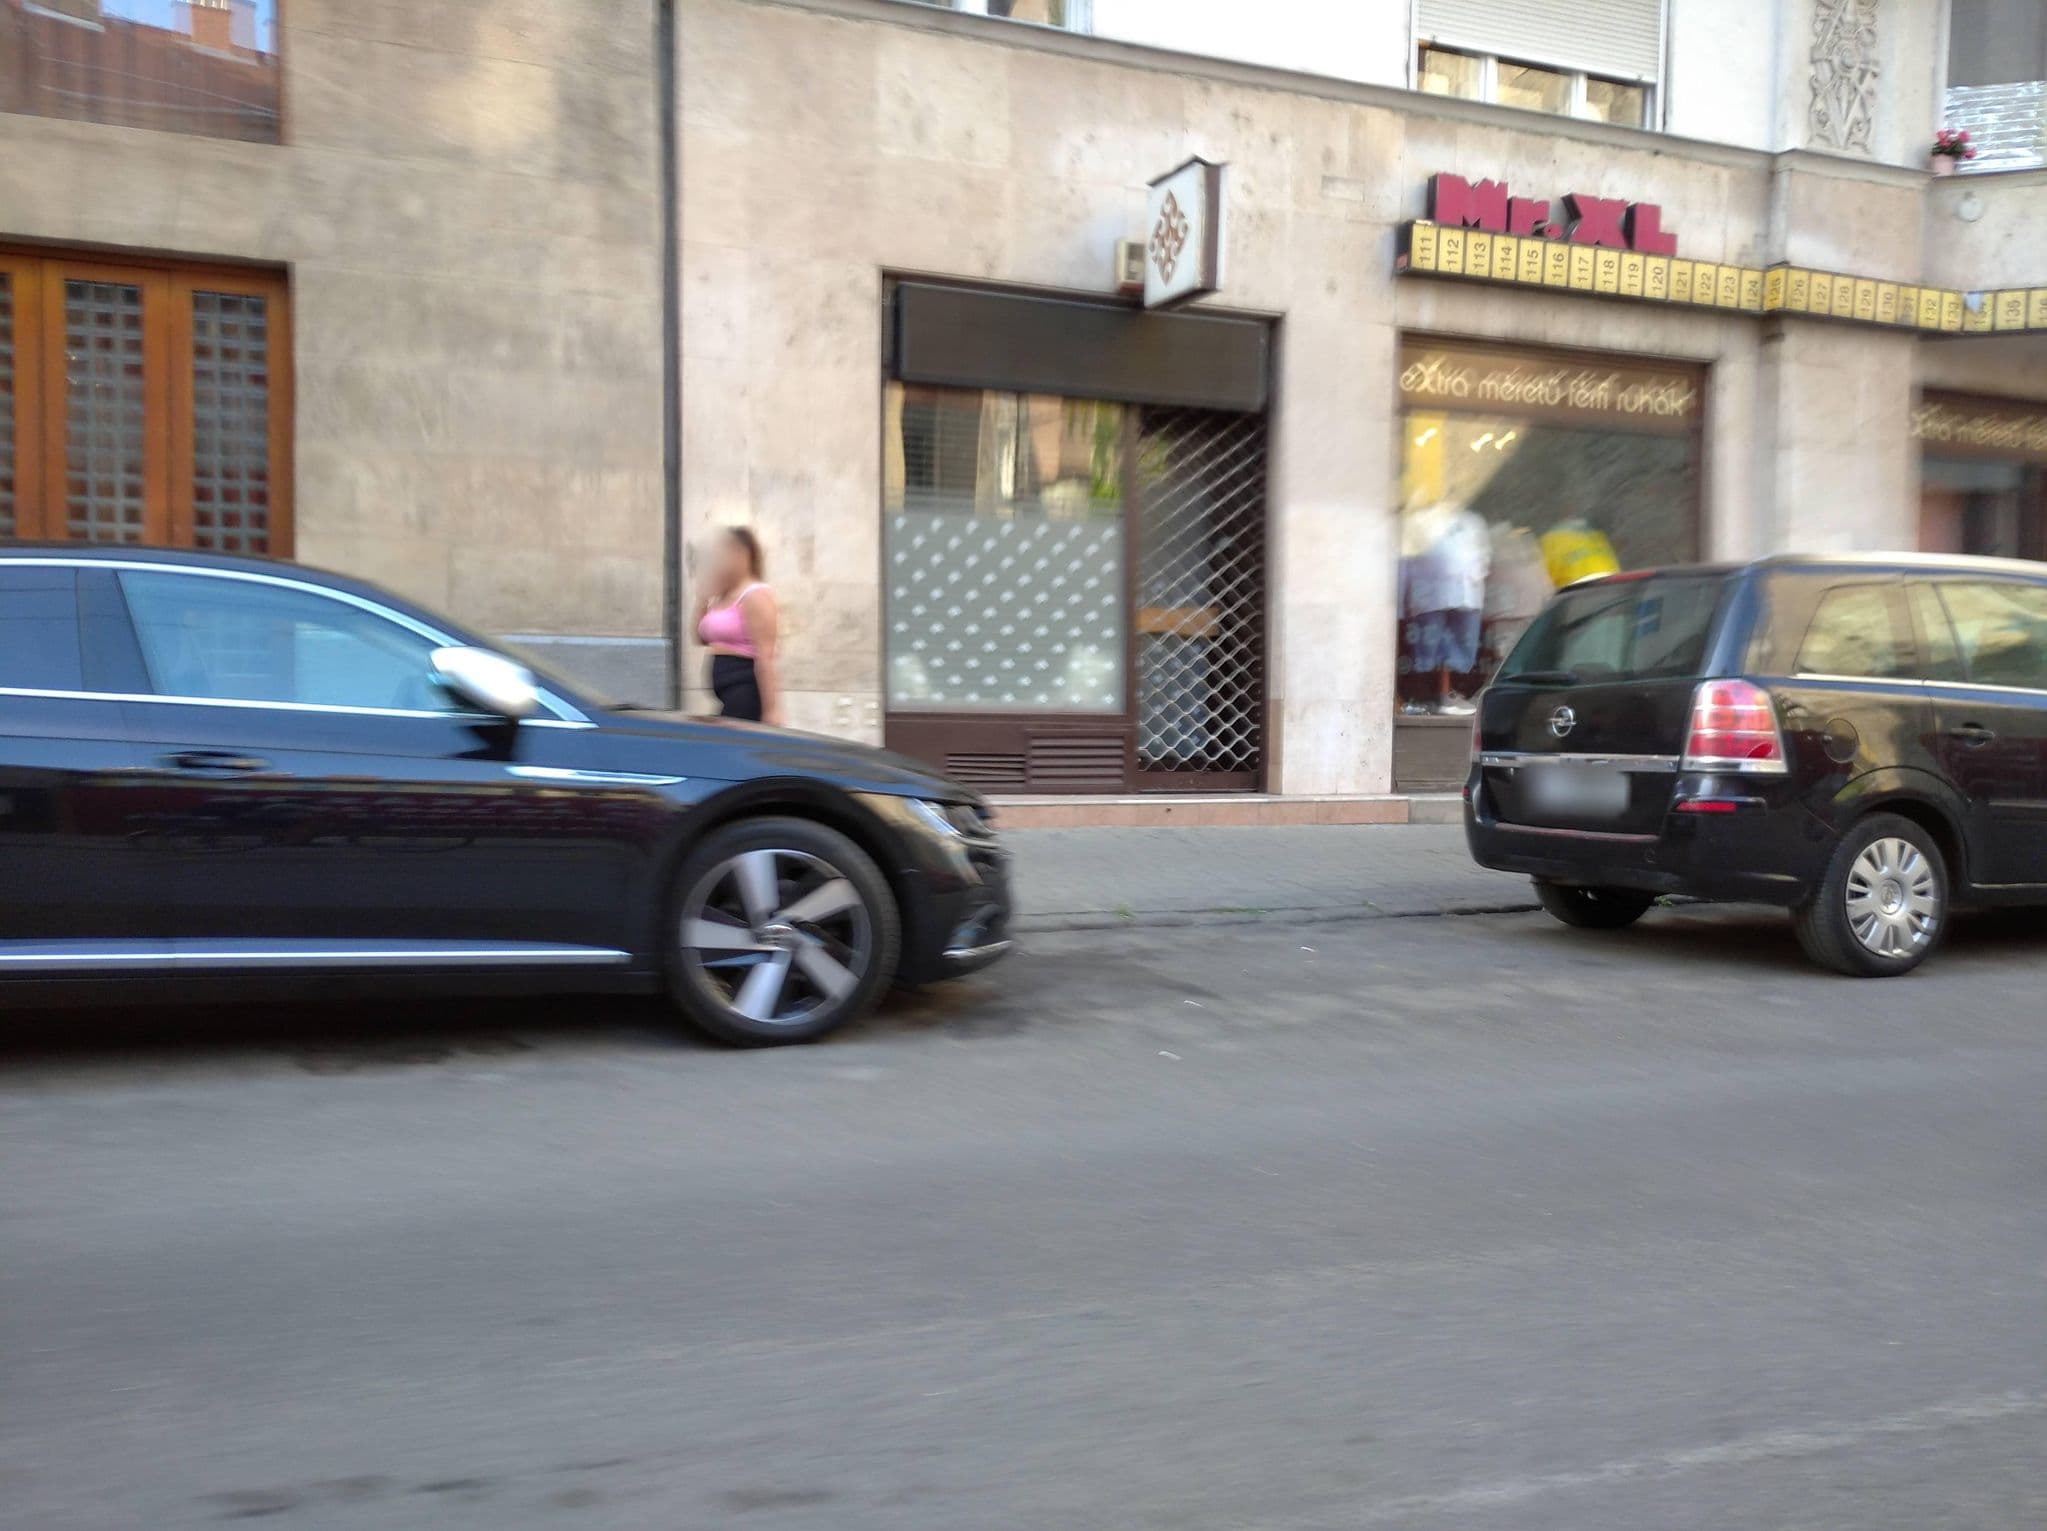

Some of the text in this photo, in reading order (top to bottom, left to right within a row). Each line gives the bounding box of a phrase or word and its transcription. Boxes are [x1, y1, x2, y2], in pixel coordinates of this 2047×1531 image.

[1430, 173, 1678, 256] Mr. XL
[1419, 236, 1432, 263] 111
[1446, 238, 1459, 266] 112
[1473, 242, 1486, 269] 113
[1500, 246, 1512, 272] 114
[1526, 249, 1539, 276] 115
[1551, 252, 1565, 279] 116
[1577, 256, 1590, 282] 117
[1602, 260, 1615, 286] 118
[1627, 263, 1640, 289] 119
[1652, 266, 1664, 292] 120
[1676, 271, 1688, 295] 121
[1700, 272, 1712, 297] 122
[1724, 276, 1736, 301] 123
[1747, 279, 1759, 303] 124
[1792, 279, 1805, 303] 126
[1815, 282, 1827, 306] 127
[1838, 285, 1849, 309] 128
[1860, 288, 1872, 312] 129
[1882, 291, 1894, 315] 130
